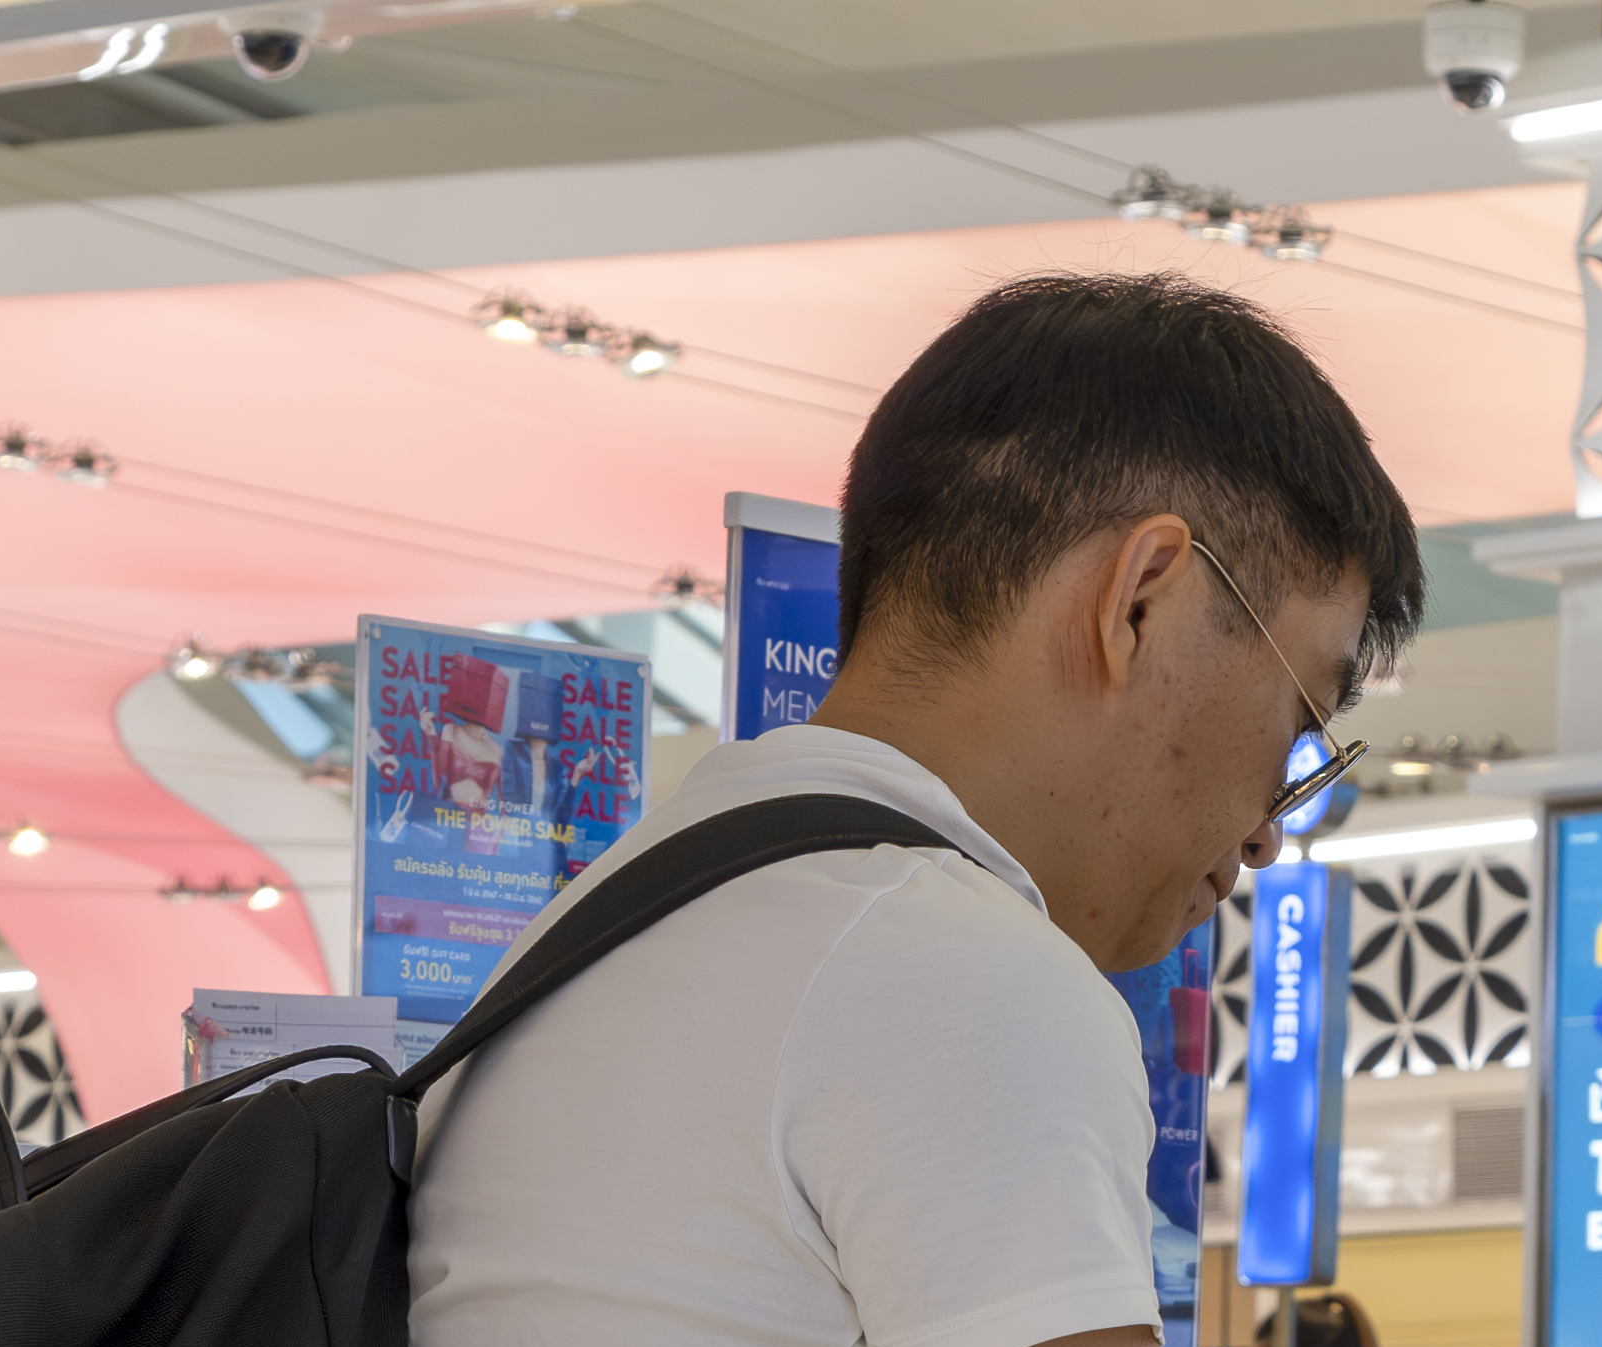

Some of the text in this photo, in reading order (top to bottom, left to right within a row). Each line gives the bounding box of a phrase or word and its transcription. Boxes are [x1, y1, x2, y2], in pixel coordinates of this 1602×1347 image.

[381, 646, 455, 685] SALE
[765, 637, 838, 680] KING
[561, 672, 633, 712] SALE
[380, 723, 441, 761] SAL
[560, 711, 632, 750] SALE
[434, 807, 467, 829] THE
[470, 814, 533, 837] POWER
[535, 821, 577, 844] SALE
[575, 790, 630, 825] ALE
[400, 959, 452, 983] 3,000
[1270, 893, 1305, 1063] CASHIER
